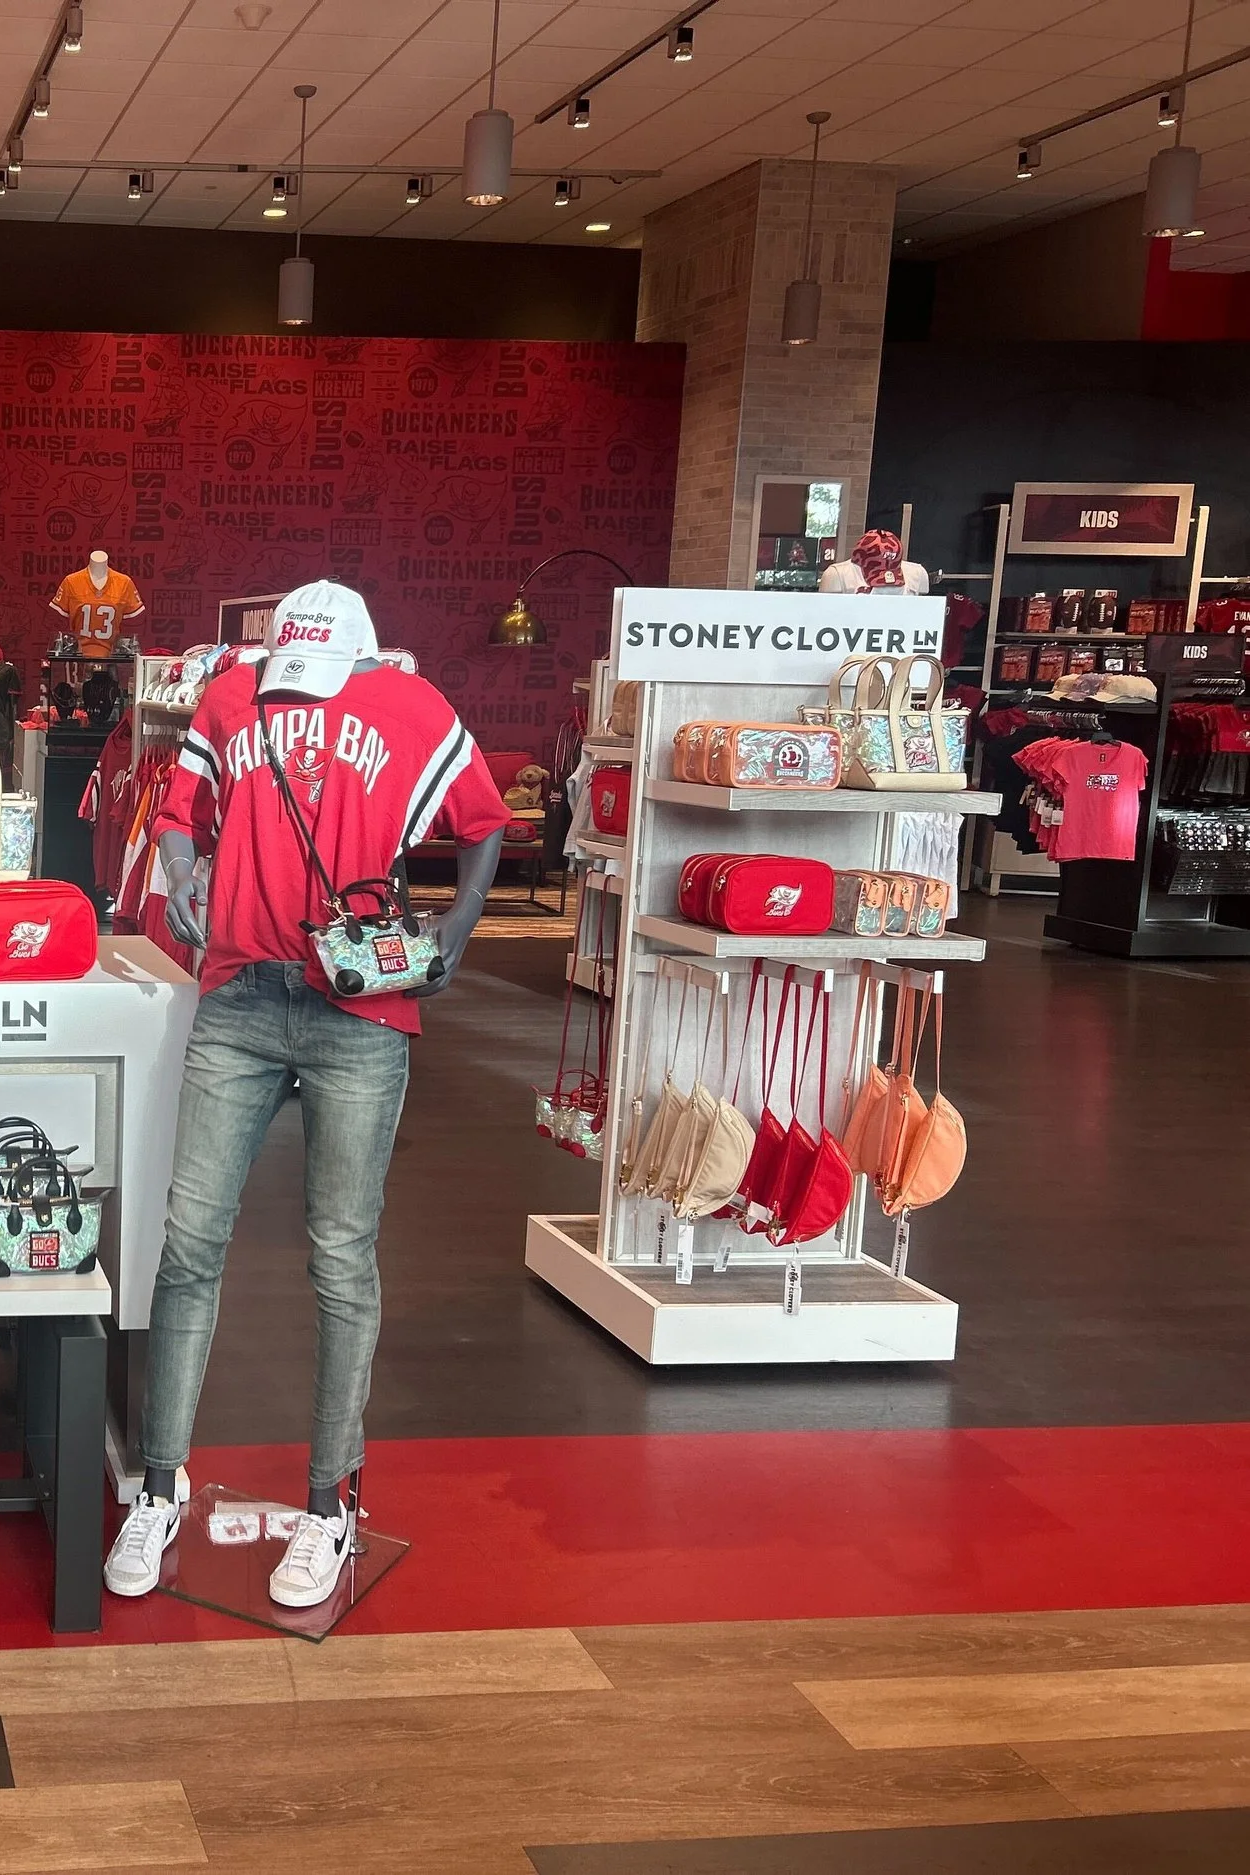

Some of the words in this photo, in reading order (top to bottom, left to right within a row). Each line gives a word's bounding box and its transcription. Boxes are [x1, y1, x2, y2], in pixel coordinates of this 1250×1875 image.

[181, 334, 317, 360] BUCCANEERS
[111, 334, 144, 393] BUC
[186, 363, 256, 378] RAISE
[29, 372, 53, 386] 1976
[230, 380, 307, 395] FLAGS
[315, 380, 363, 397] KREWE
[1, 402, 136, 432] BUCCANEERS
[381, 408, 518, 437] BUCCANEERS
[7, 434, 77, 450] RAISE
[310, 401, 346, 470] BUCS
[387, 439, 456, 454] RAISE
[50, 451, 126, 467] FLAGS
[134, 452, 182, 469] KREWE
[430, 456, 507, 471] FLAGS
[200, 480, 334, 509] BUCCANEERS
[580, 484, 675, 511] BUCCANE
[130, 471, 166, 541] BUCS
[508, 476, 546, 545] BUCS
[49, 519, 73, 534] 1976
[205, 511, 275, 526] RAISE
[584, 515, 656, 531] RAISE
[1079, 510, 1119, 528] KIDS
[248, 527, 325, 542] FLAGS
[331, 527, 381, 544] KREWE
[397, 555, 534, 583] BUCCANEERS
[403, 586, 473, 601] RAISE
[286, 611, 313, 623] Tampa
[314, 612, 335, 624] Bay
[446, 602, 507, 617] FLAG
[1234, 611, 1250, 621] EVAN
[80, 604, 116, 640] 13
[242, 608, 274, 641] WOMEN
[278, 621, 332, 647] Bucs
[626, 621, 765, 650] STONEY
[771, 625, 906, 654] CLOVER
[914, 629, 938, 647] LN
[1183, 645, 1208, 659] KIDS
[225, 708, 325, 782] TAMPA
[337, 712, 391, 796] BAY
[376, 943, 390, 956] GO
[380, 957, 407, 971] BUCS
[2, 1000, 47, 1027] LN
[32, 1239, 44, 1250] GO
[32, 1254, 57, 1267] BUCS
